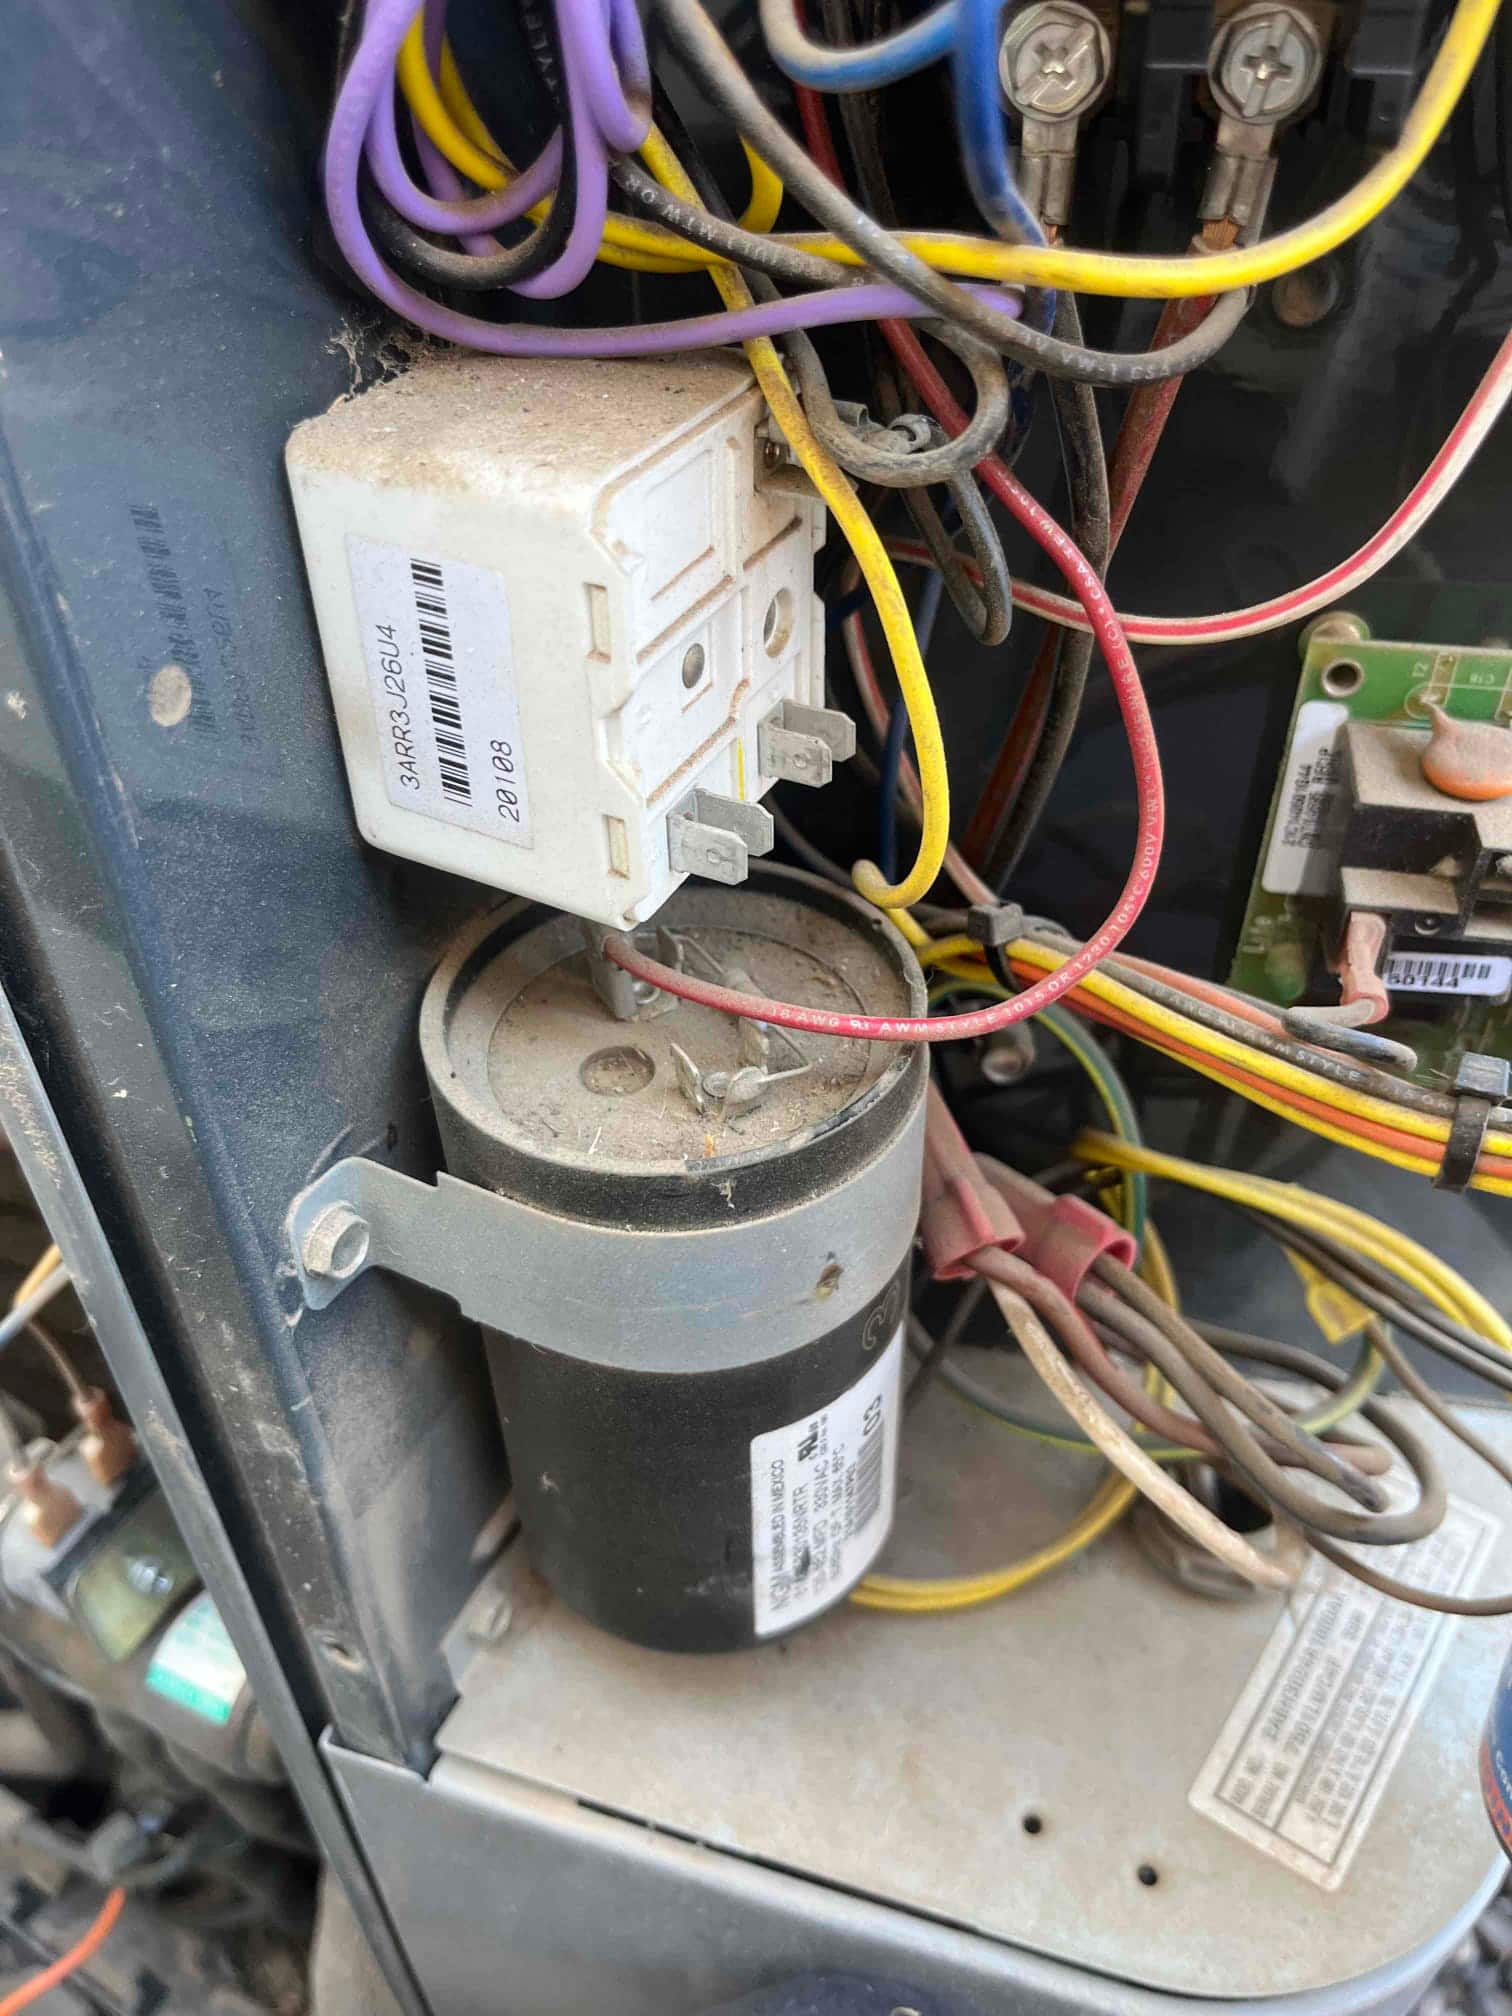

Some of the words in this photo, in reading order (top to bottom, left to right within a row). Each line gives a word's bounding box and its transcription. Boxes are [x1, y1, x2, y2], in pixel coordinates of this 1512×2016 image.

[375, 623, 420, 791] 3ARR3J26U4
[490, 739, 521, 823] 20108
[799, 1013, 840, 1028] AWG
[880, 1022, 928, 1033] AWM
[936, 1011, 998, 1034] STYLE
[1002, 991, 1045, 1017] 1015
[1047, 972, 1073, 990] OR
[1139, 832, 1157, 880] 600V
[1296, 1049, 1362, 1083] STYLE
[861, 1395, 882, 1437] 03
[769, 1458, 785, 1503] MEXICO
